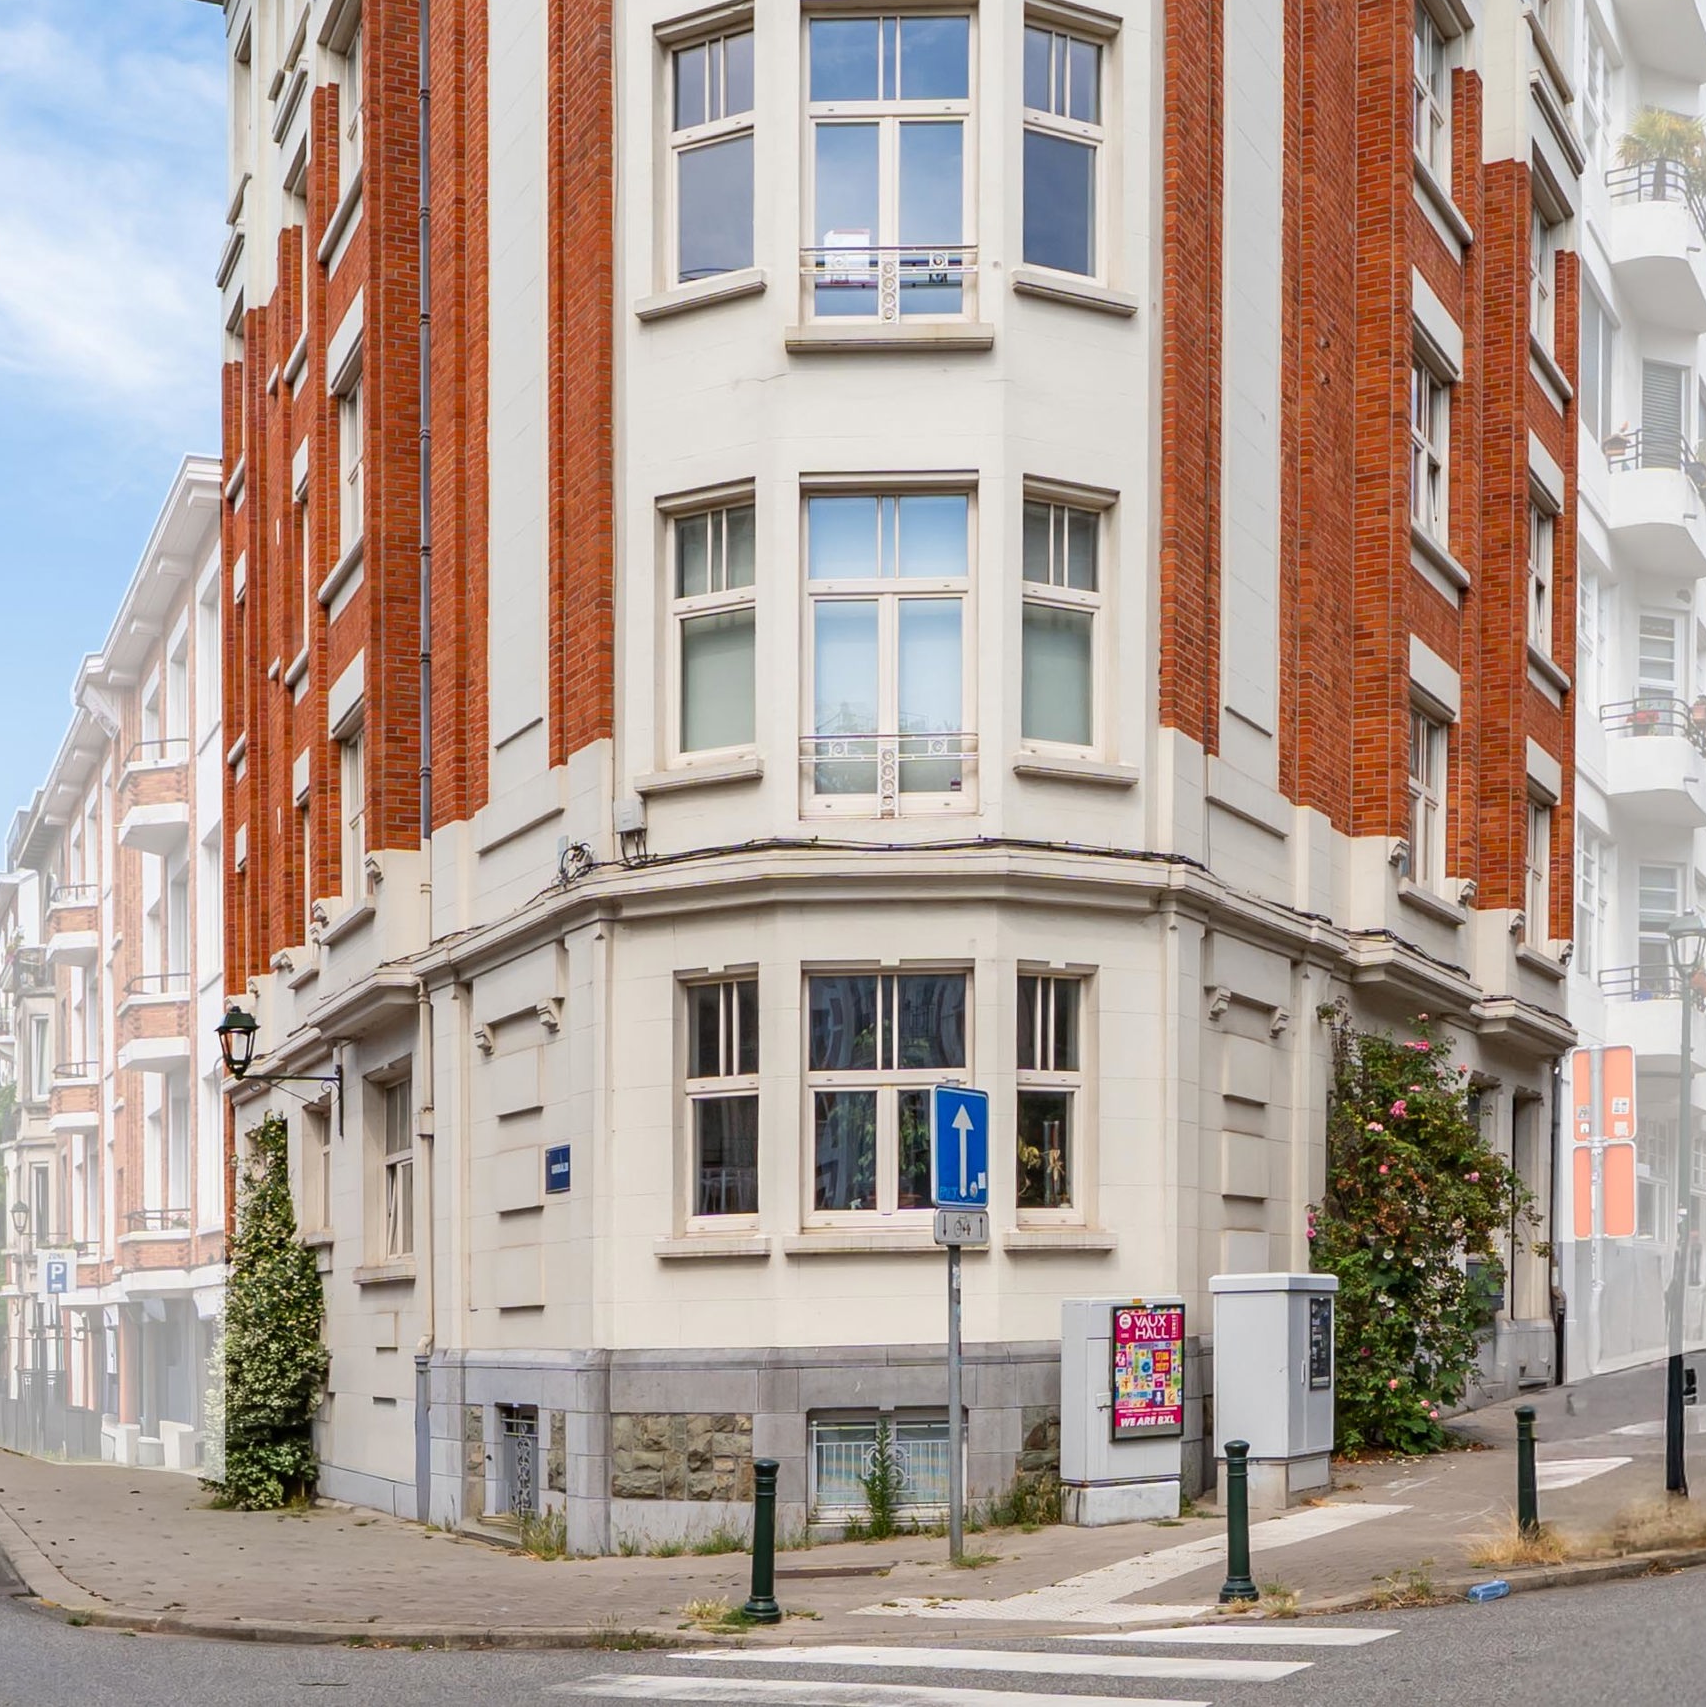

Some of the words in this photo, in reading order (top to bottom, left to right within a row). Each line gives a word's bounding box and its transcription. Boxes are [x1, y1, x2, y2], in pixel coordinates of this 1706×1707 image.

[51, 1264, 64, 1280] P
[1134, 1315, 1166, 1327] VAUX
[1135, 1328, 1169, 1340] HALL
[1120, 1416, 1136, 1427] WE
[1137, 1415, 1156, 1426] ARE
[1157, 1414, 1175, 1425] BXL
